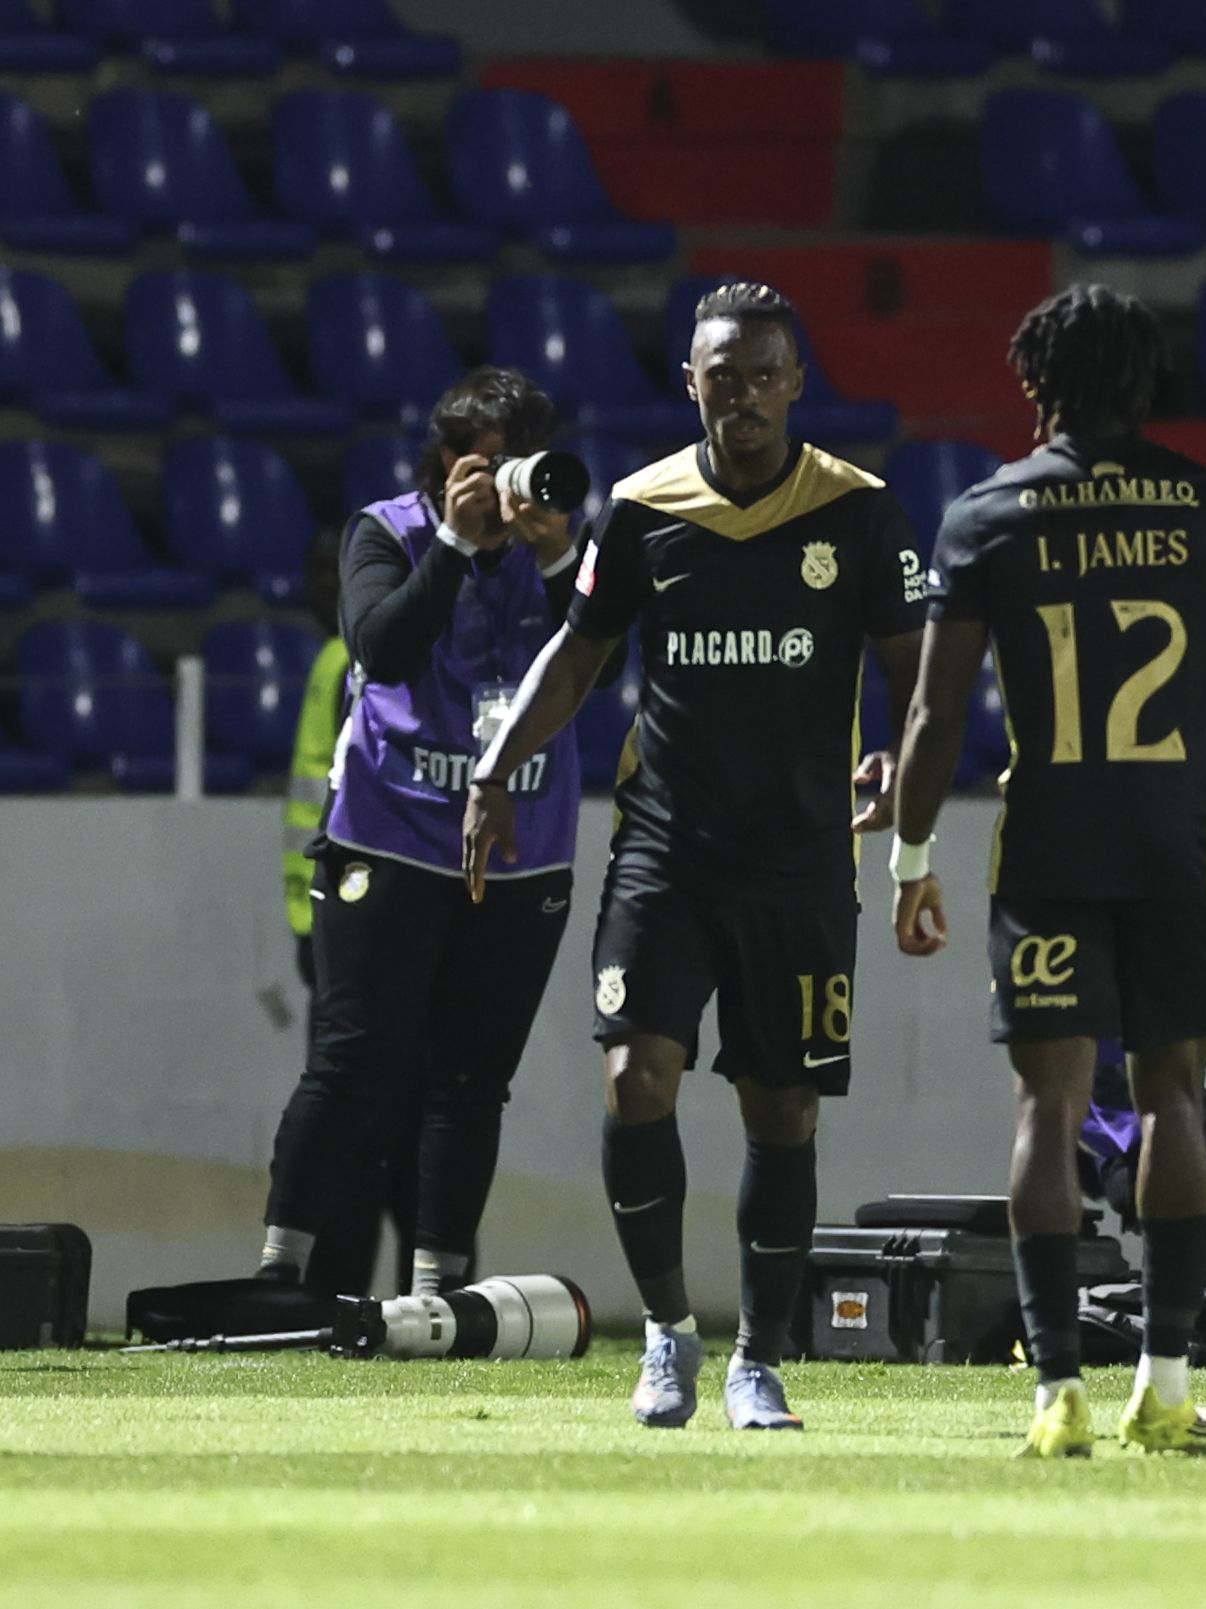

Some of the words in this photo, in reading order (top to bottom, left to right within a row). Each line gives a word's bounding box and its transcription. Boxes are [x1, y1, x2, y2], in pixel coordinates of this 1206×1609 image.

[1077, 529, 1189, 577] JAMES
[1034, 600, 1188, 764] 12
[796, 973, 851, 1042] 18
